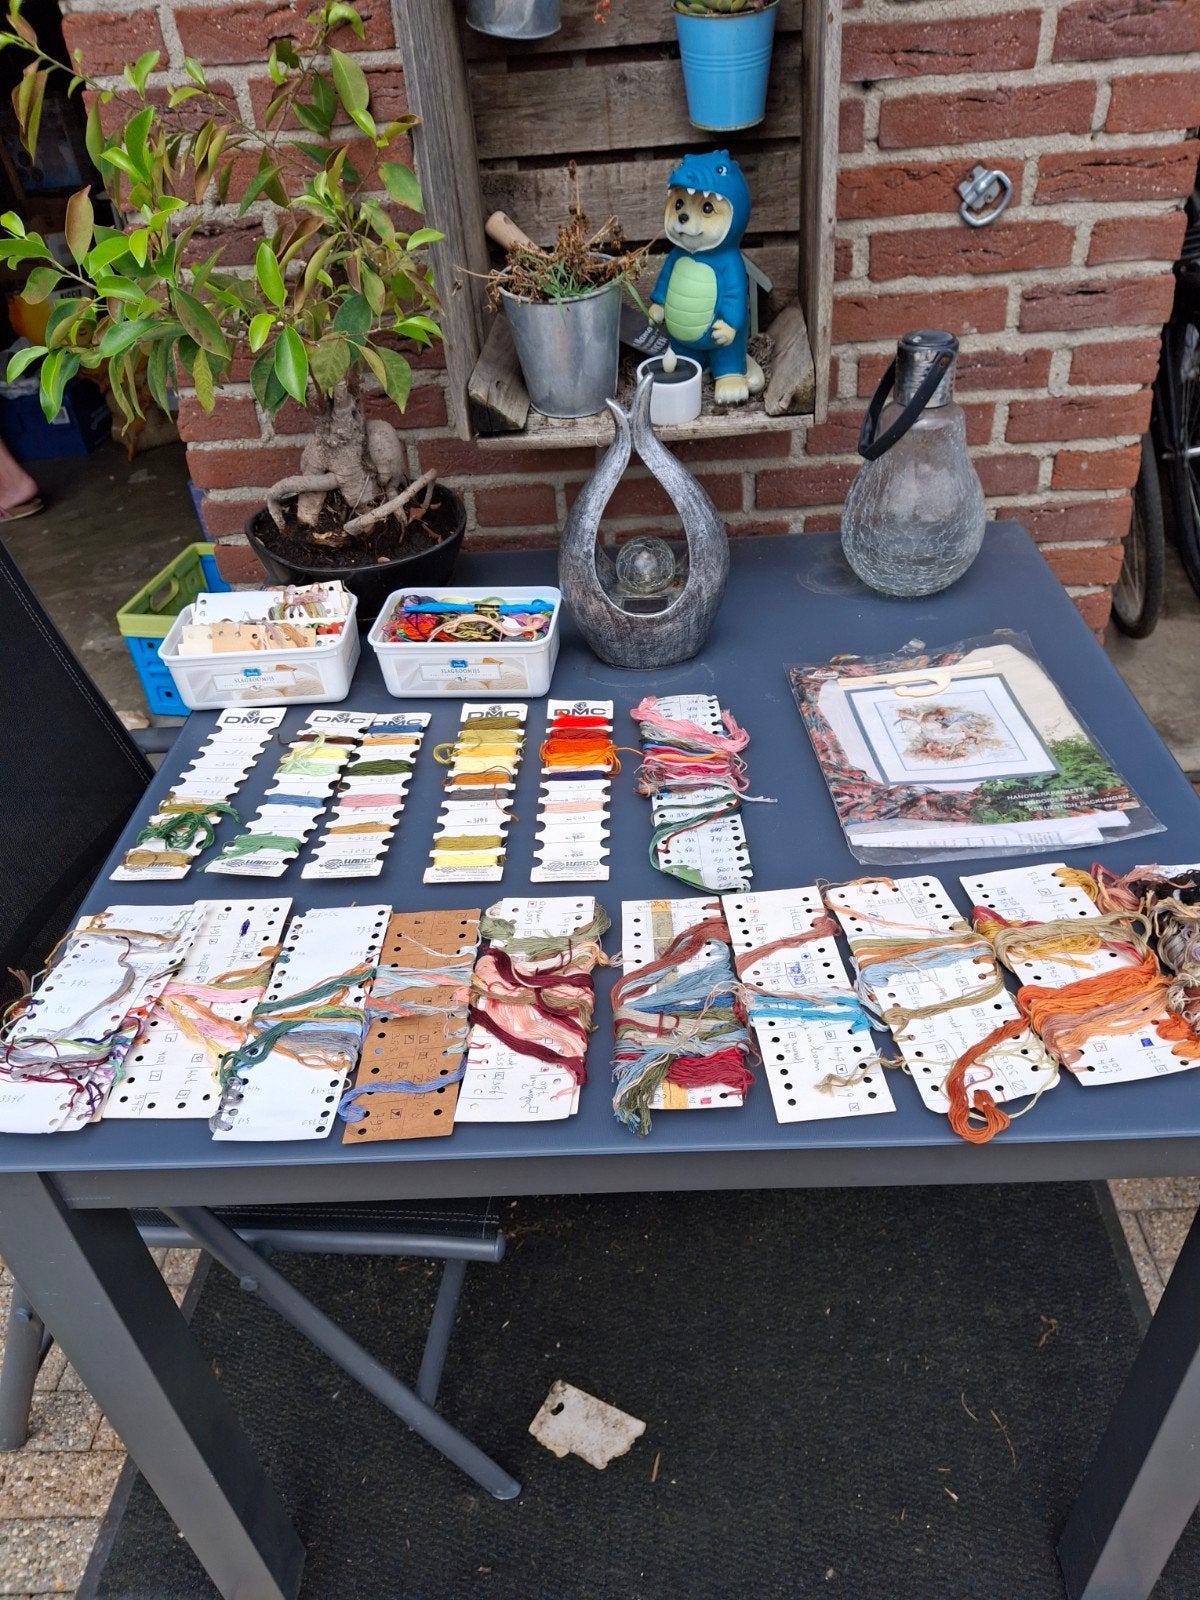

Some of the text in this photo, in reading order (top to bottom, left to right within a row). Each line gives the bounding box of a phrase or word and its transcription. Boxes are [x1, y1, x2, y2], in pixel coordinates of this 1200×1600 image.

[234, 675, 275, 684] SLAGROOMIJS
[467, 710, 520, 718] DMC
[553, 708, 607, 717] DMC
[223, 716, 276, 725] DMC
[313, 716, 367, 724] DMC
[1071, 793, 1089, 801] KITS
